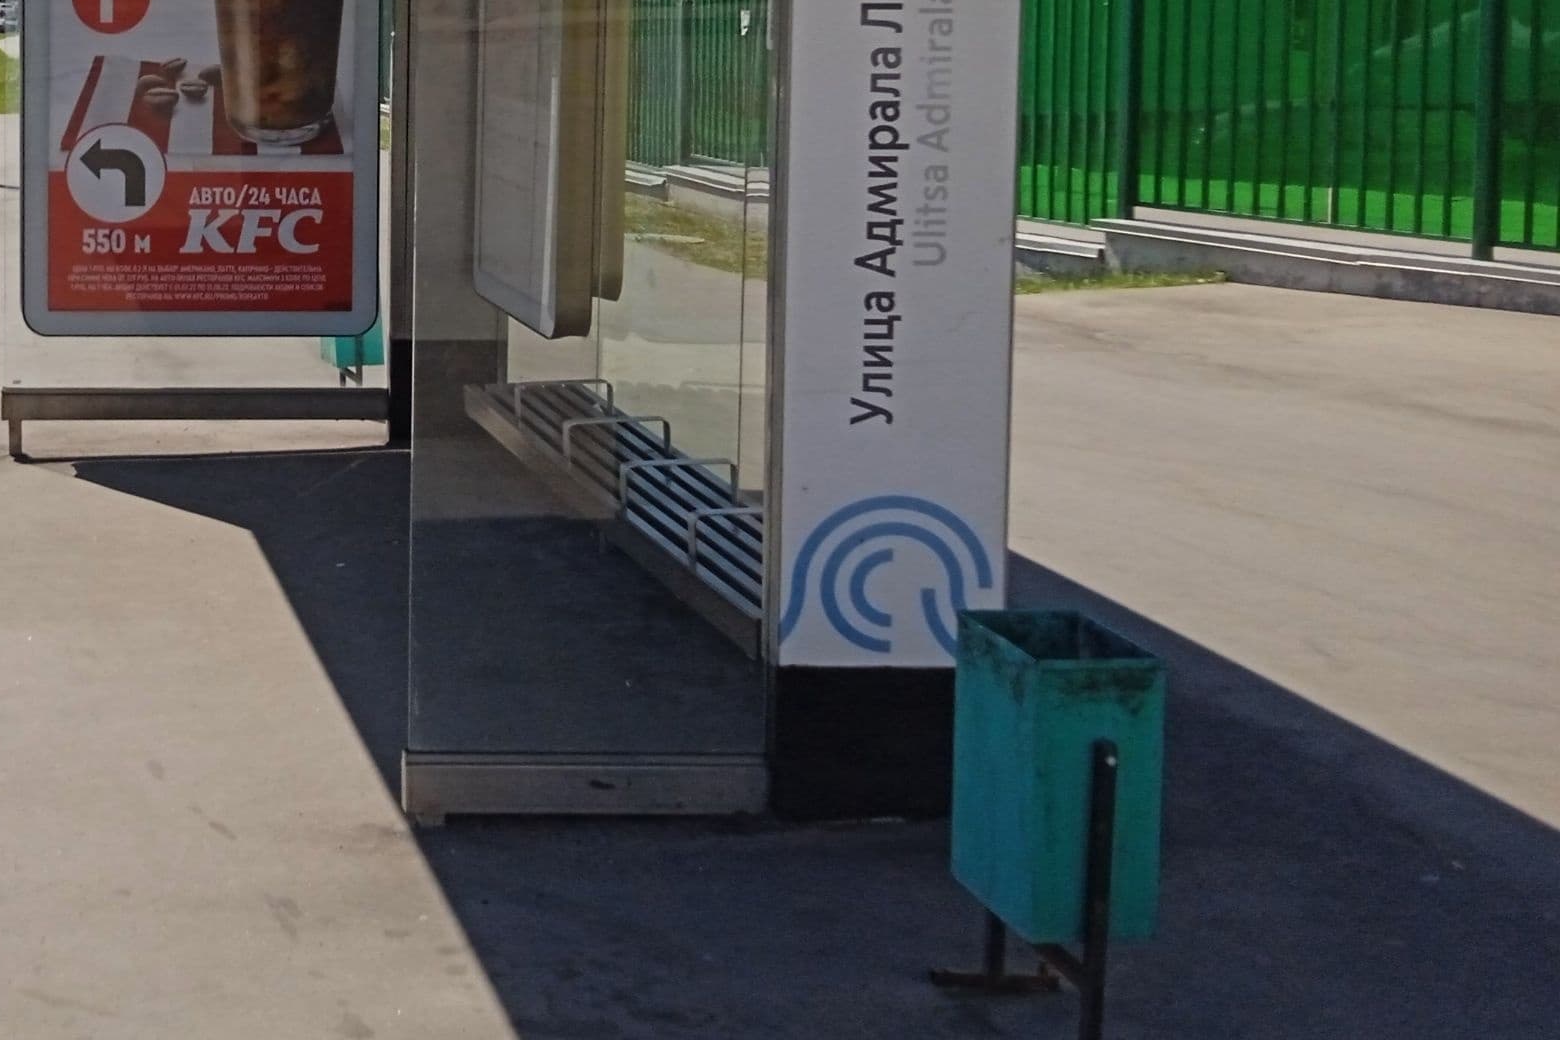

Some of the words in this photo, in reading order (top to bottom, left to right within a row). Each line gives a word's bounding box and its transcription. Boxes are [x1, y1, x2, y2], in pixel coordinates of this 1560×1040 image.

[190, 185, 270, 206] АВТО/24
[277, 187, 322, 205] ЧАСА
[854, 47, 910, 278] Адмирала
[82, 229, 125, 253] 550
[179, 208, 323, 253] KFC
[913, 165, 949, 266] Ulitsa
[850, 291, 902, 424] Улица
